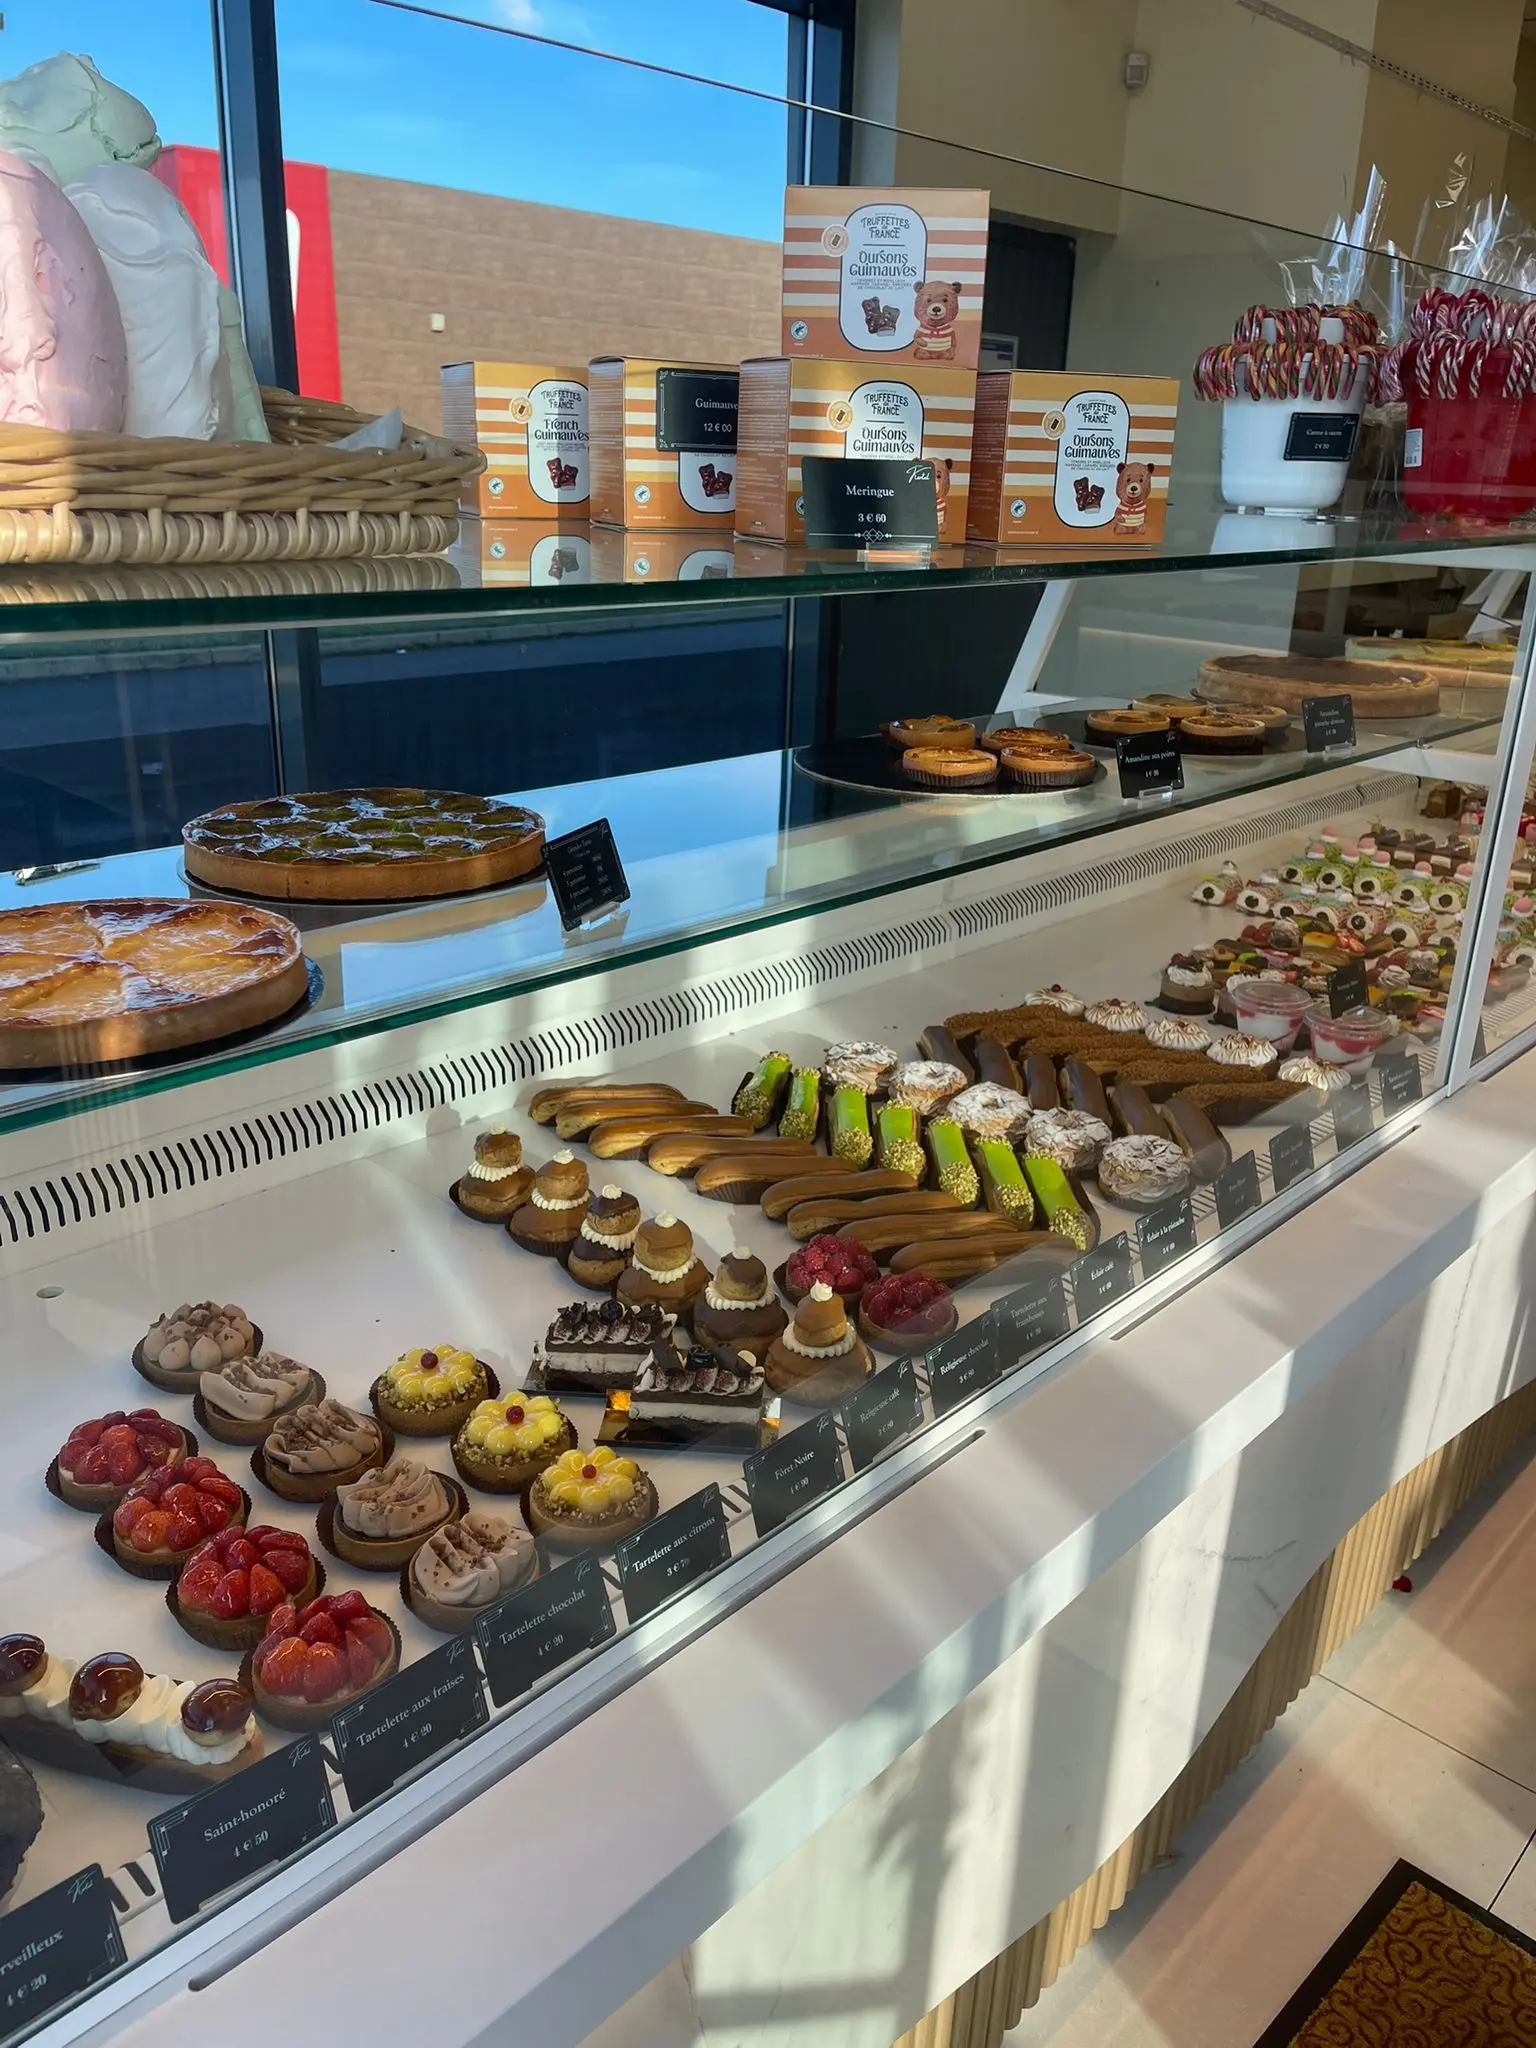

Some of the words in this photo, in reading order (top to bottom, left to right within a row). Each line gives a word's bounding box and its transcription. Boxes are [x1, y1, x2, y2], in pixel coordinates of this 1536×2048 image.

[860, 216, 910, 229] TRUFFETTES
[869, 226, 901, 239] FRANCE
[859, 250, 908, 265] Oursons
[849, 262, 917, 277] Guimauves
[541, 390, 582, 402] TRUFFETTES
[863, 392, 909, 407] TRUFFETTES
[548, 399, 575, 410] FRANCE
[695, 397, 739, 410] Guimauve
[871, 403, 901, 416] FRANCE
[1076, 402, 1117, 415] TRUFFETTES
[543, 418, 579, 430] French
[1082, 411, 1109, 424] FRANCE
[703, 422, 713, 432] 12
[714, 423, 720, 432] €
[721, 423, 732, 433] 00
[862, 426, 907, 441] Oursons
[534, 429, 590, 441] Guimauves
[1073, 434, 1115, 447] Oursons
[853, 439, 915, 454] Guimauves
[1064, 446, 1121, 459] Guimauves
[845, 484, 895, 498] Meringue
[857, 512, 864, 523] 3
[866, 513, 874, 523] €
[875, 512, 887, 523] 60
[940, 1353, 967, 1375] Religieuse
[889, 1387, 900, 1402] café
[794, 1451, 815, 1468] Noire
[632, 1543, 672, 1573] Tartelette
[673, 1533, 688, 1548] aux
[688, 1516, 716, 1538] citrons
[666, 1567, 673, 1577] 3
[673, 1562, 680, 1573] €
[499, 1613, 546, 1645] Tartelette
[547, 1589, 586, 1618] chocolat
[544, 1642, 552, 1652] €
[355, 1708, 409, 1748] Tartelette
[411, 1694, 432, 1713] aux
[432, 1672, 465, 1699] fraises
[402, 1737, 409, 1749] 4
[410, 1730, 419, 1743] €
[420, 1722, 433, 1737] 20
[203, 1787, 287, 1842] Saint-honoré
[232, 1845, 241, 1858] 4
[243, 1839, 253, 1851] €
[254, 1829, 269, 1846] 50
[6, 1993, 14, 2007] 4
[17, 1984, 29, 2000] €
[30, 1972, 48, 1992] 20
